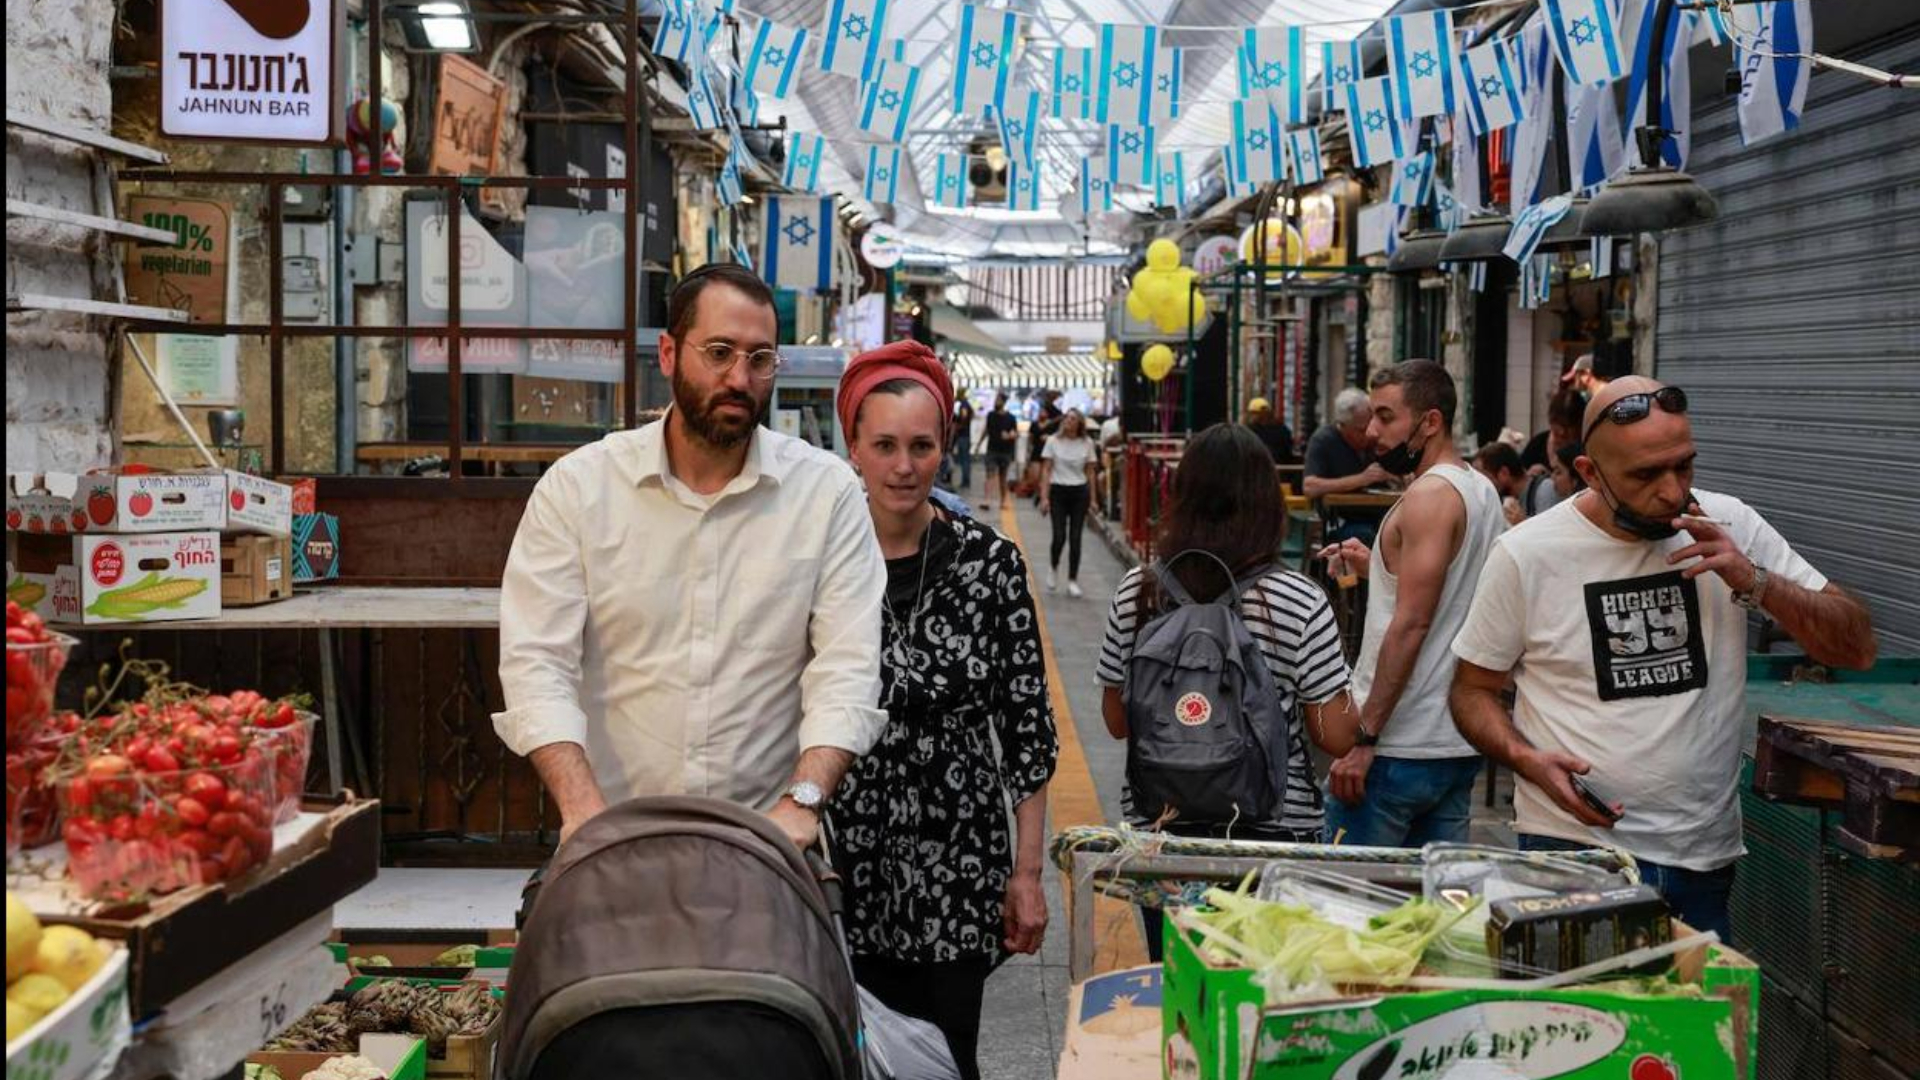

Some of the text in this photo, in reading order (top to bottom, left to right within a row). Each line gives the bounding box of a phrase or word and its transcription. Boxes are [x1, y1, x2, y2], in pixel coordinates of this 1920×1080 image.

[178, 51, 310, 94] ג'חנונבר
[179, 97, 310, 117] JAHNUN BAR
[141, 253, 212, 277] vegetarian
[174, 550, 216, 569] החוף
[1601, 585, 1685, 614] HIGHER
[1612, 660, 1694, 690] LEAGUE
